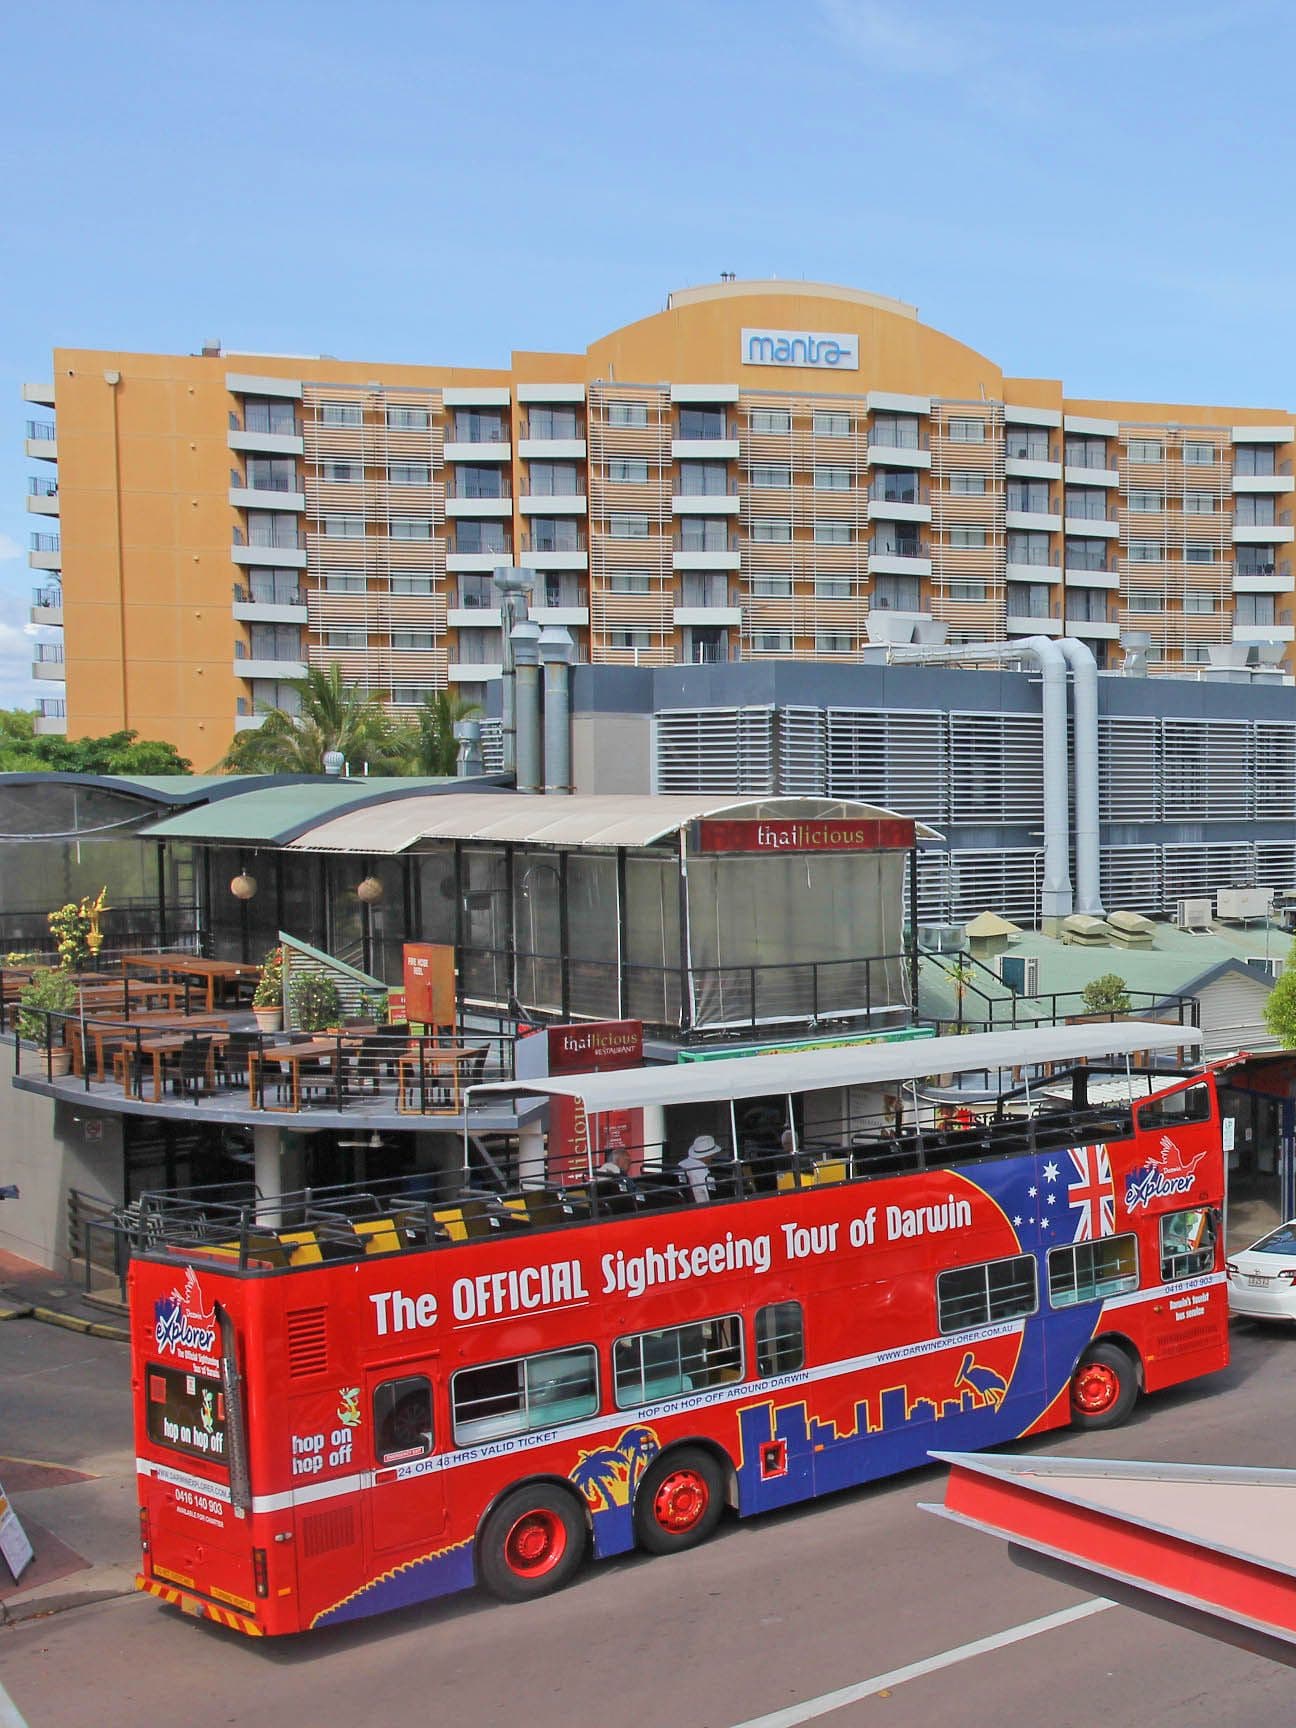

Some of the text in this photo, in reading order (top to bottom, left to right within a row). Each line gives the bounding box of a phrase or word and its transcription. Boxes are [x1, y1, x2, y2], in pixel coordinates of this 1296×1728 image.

[749, 336, 851, 364] mantra
[758, 825, 864, 848] thailicious
[564, 1033, 638, 1051] thailicious
[595, 1045, 636, 1055] RESTAURANT
[369, 1194, 972, 1335] The OFFICIAL Sightseeing Tour of Darwin
[1186, 1279, 1198, 1289] 140
[877, 1325, 1013, 1362] WWW.DARWINEXPLORER.COM.AU
[638, 1371, 809, 1419] HOP ON HOP OFF AROUND DARWIN
[164, 1417, 223, 1453] hop on hop off
[292, 1428, 352, 1454] hop on
[292, 1443, 352, 1475] hop off
[399, 1430, 558, 1477] 24 OR 48 HRS VALID TICKET
[175, 1488, 223, 1515] 0416 140 903
